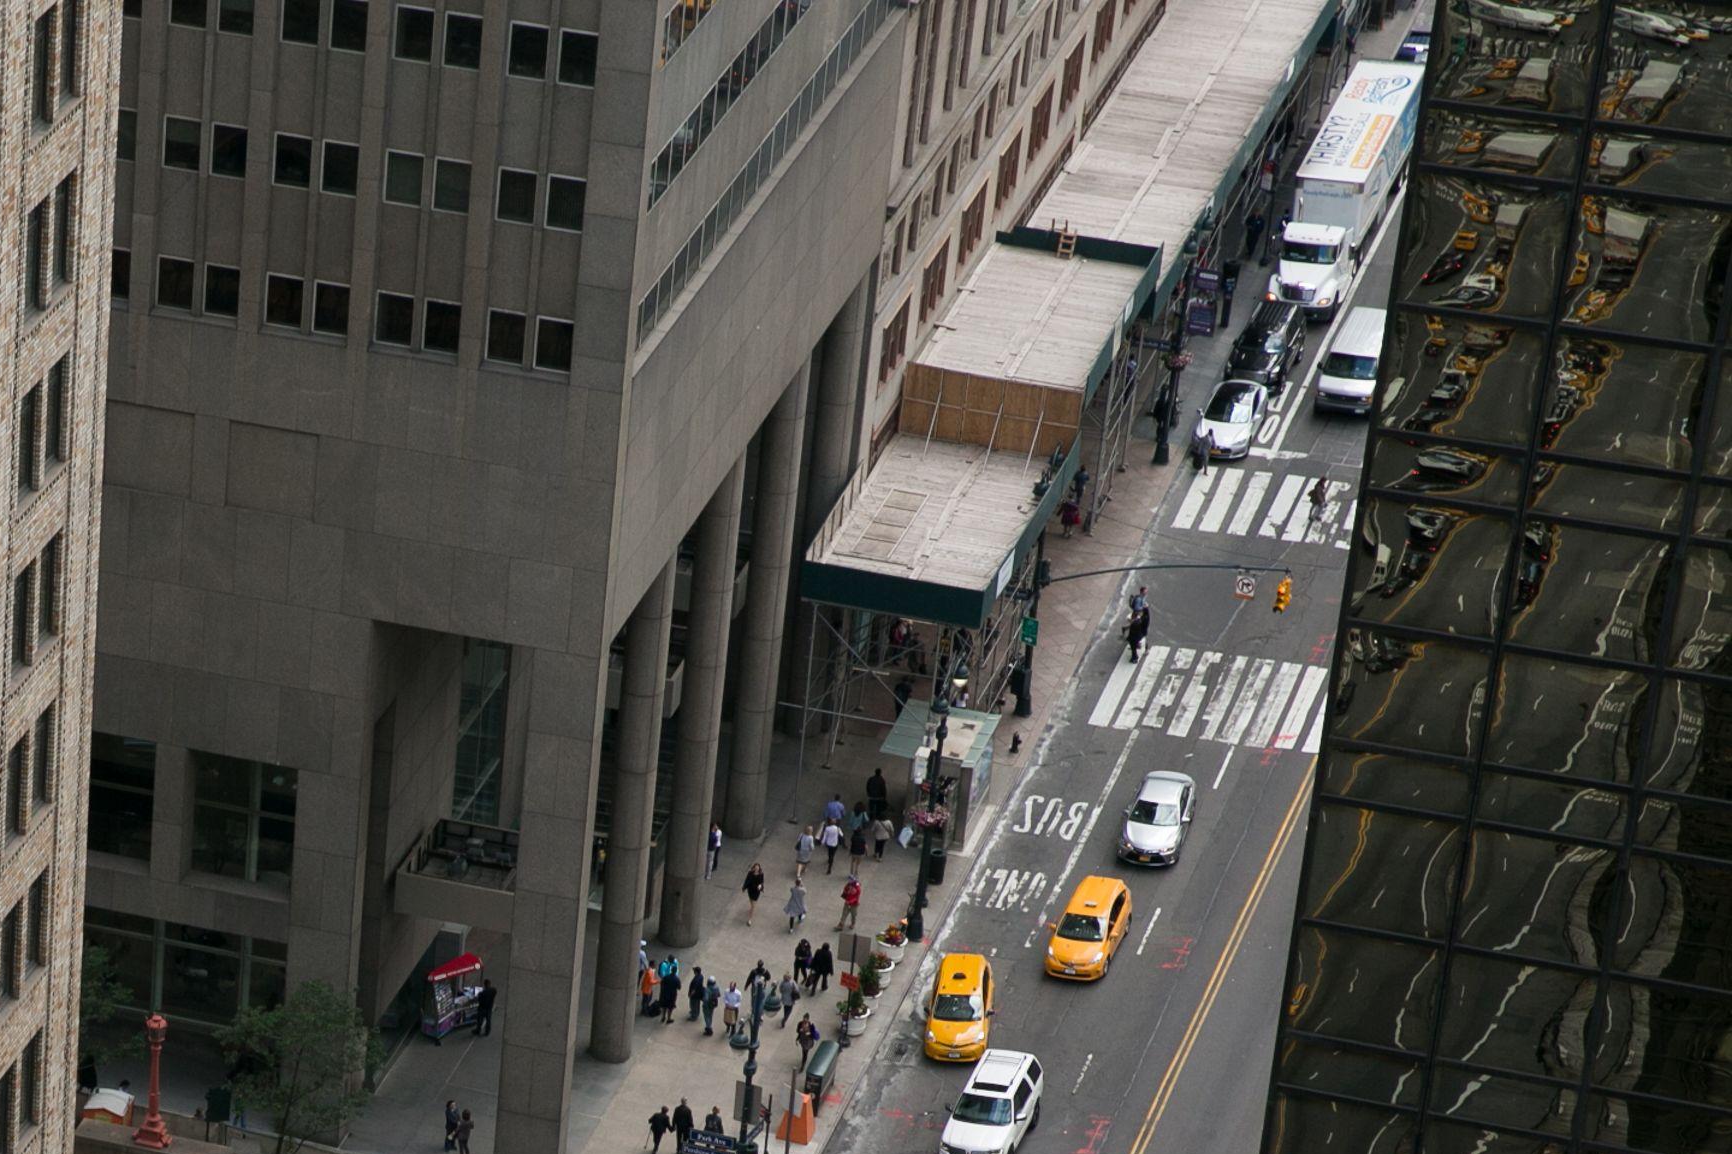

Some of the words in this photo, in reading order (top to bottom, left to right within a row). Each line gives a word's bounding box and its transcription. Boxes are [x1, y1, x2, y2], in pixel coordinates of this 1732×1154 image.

[1306, 115, 1353, 165] THIRSTY?
[1013, 795, 1089, 840] BUS
[697, 1134, 712, 1143] Park
